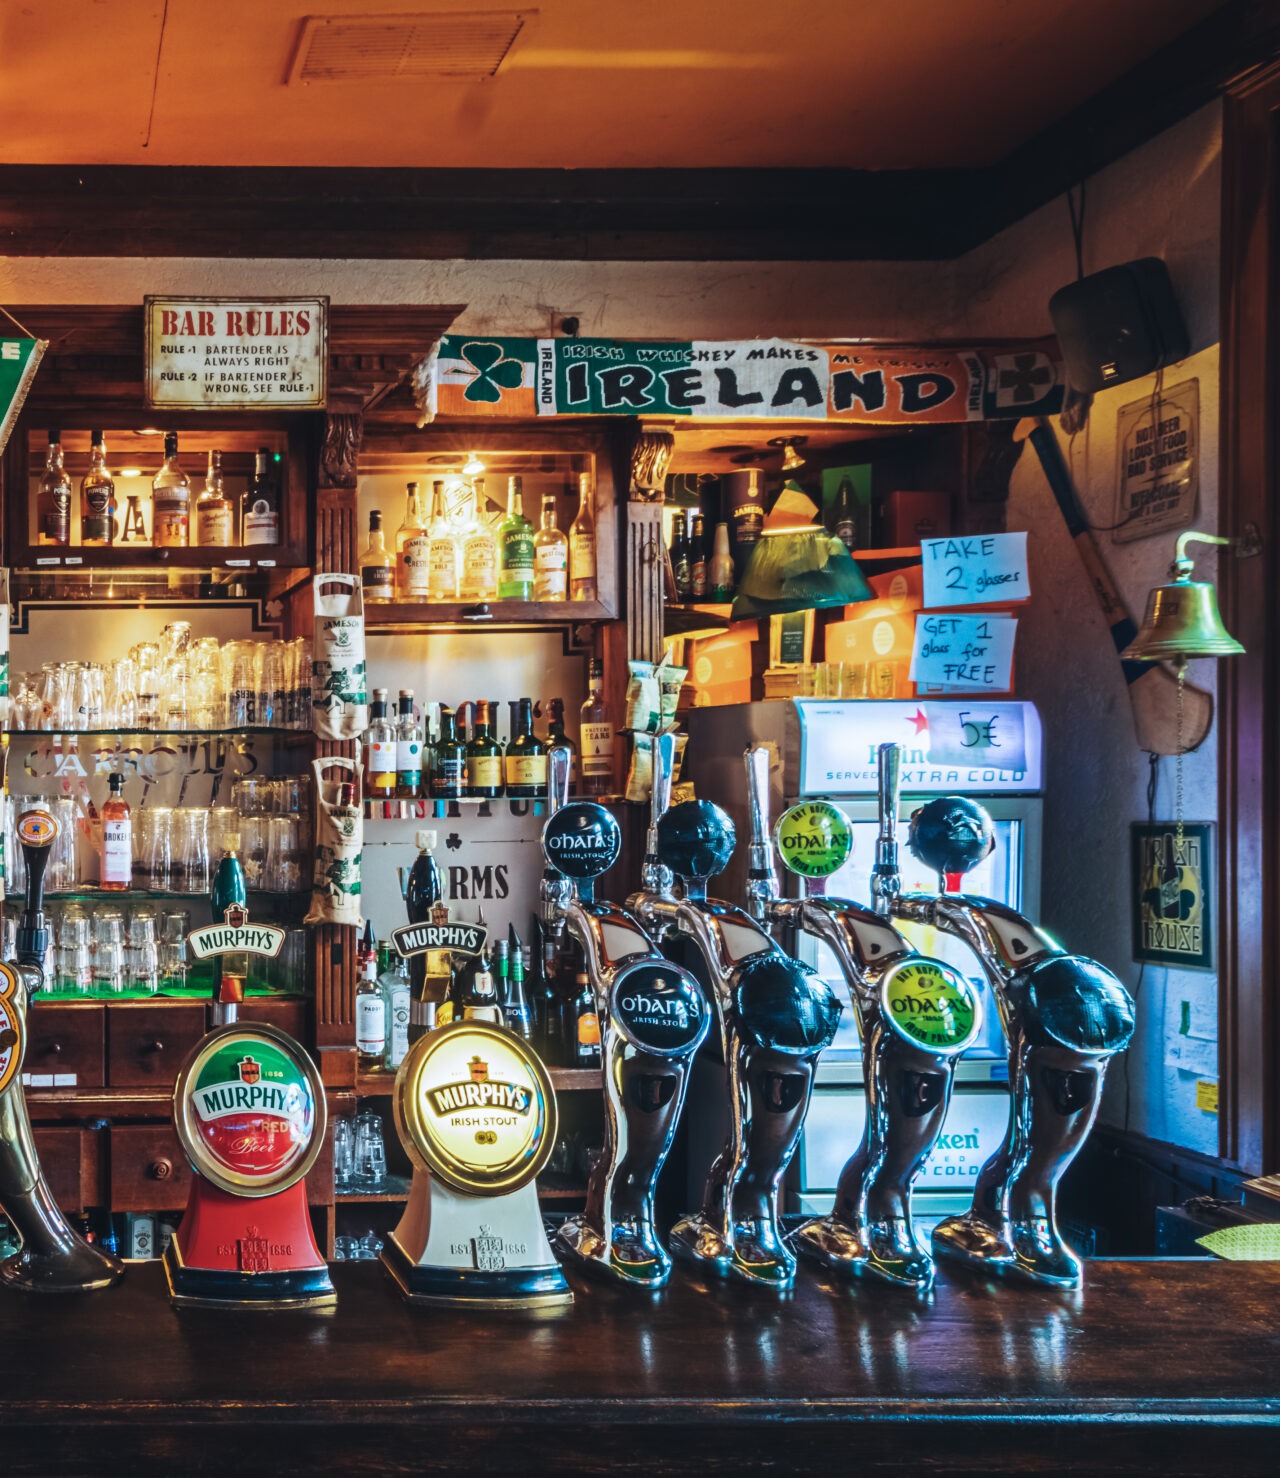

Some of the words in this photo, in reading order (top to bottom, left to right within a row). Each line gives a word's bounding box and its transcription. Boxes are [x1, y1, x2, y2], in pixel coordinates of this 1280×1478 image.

[161, 310, 216, 336] BAR
[226, 310, 311, 337] RULES
[161, 345, 185, 354] RULE
[206, 345, 273, 355] BARTENDER
[277, 345, 288, 354] IS
[562, 345, 625, 360] IRISH
[636, 348, 737, 363] WHISKEY
[745, 346, 819, 363] MAKES
[832, 353, 864, 365] ME
[204, 357, 250, 366] ALWAYS
[254, 357, 290, 366] RIGHT
[160, 372, 185, 381] RULE
[204, 372, 215, 381] IF
[220, 372, 287, 382] BARTENDER
[292, 372, 303, 381] IS
[541, 346, 553, 405] IRELAND
[253, 384, 273, 393] SEE
[279, 383, 304, 393] RULE
[565, 360, 957, 413] IRELAND
[928, 538, 996, 560] TAKE
[945, 566, 968, 591] 2
[976, 570, 1020, 593] glasses
[923, 617, 963, 635] GET
[976, 621, 993, 640] 1
[961, 643, 987, 662] for
[943, 663, 997, 684] FREE
[826, 771, 878, 781] SERVED
[901, 770, 959, 783] XTRA
[968, 769, 1026, 782] COLD
[199, 925, 274, 951] MURPHY'S
[402, 926, 478, 950] MURPHY'S
[635, 1016, 659, 1025] IRISH
[433, 1083, 527, 1112] MURPHY'S
[261, 1121, 289, 1133] RED
[450, 1117, 480, 1126] IRISH
[483, 1116, 519, 1126] STOUT
[932, 1165, 980, 1176] COLD
